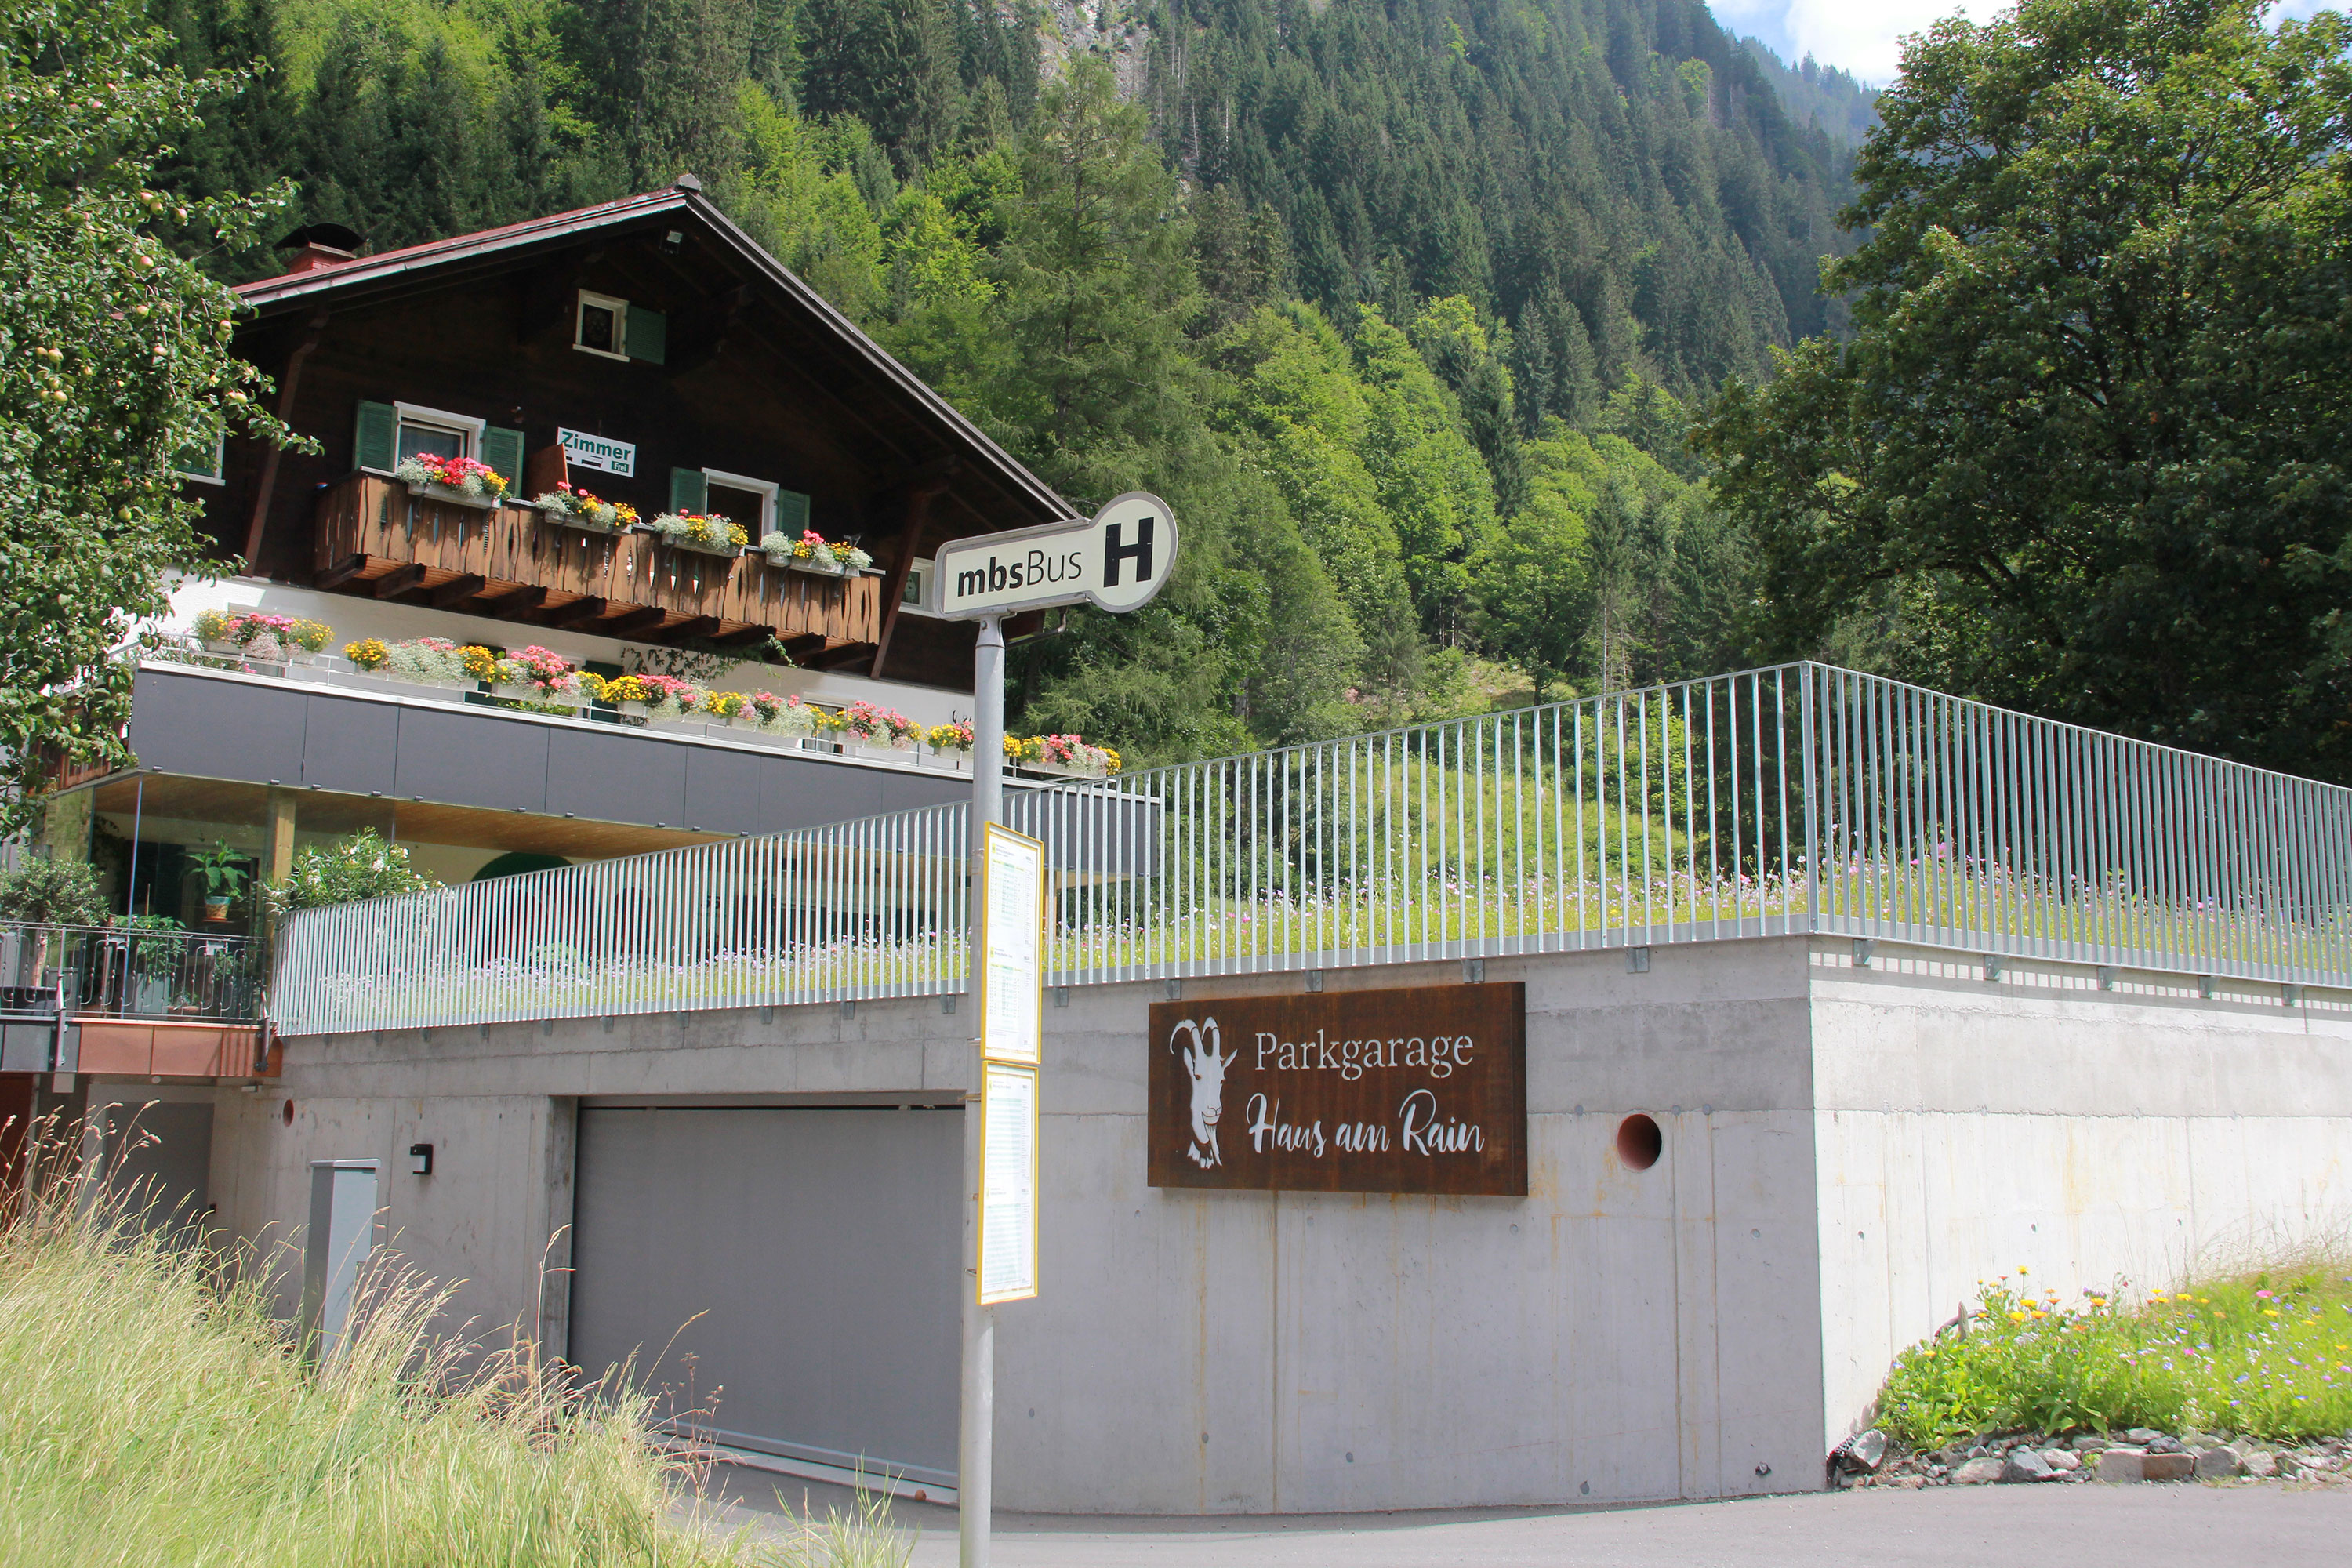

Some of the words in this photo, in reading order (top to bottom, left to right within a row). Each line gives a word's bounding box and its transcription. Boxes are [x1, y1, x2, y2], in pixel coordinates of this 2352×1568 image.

[562, 430, 631, 461] Zimmer
[614, 462, 626, 472] Frei
[957, 550, 1082, 597] mbsBus
[1103, 517, 1154, 588] H
[1254, 1028, 1474, 1081] Parkgarage
[1247, 1092, 1327, 1159] Haus
[1335, 1121, 1391, 1153] am
[1399, 1088, 1485, 1156] Rain
